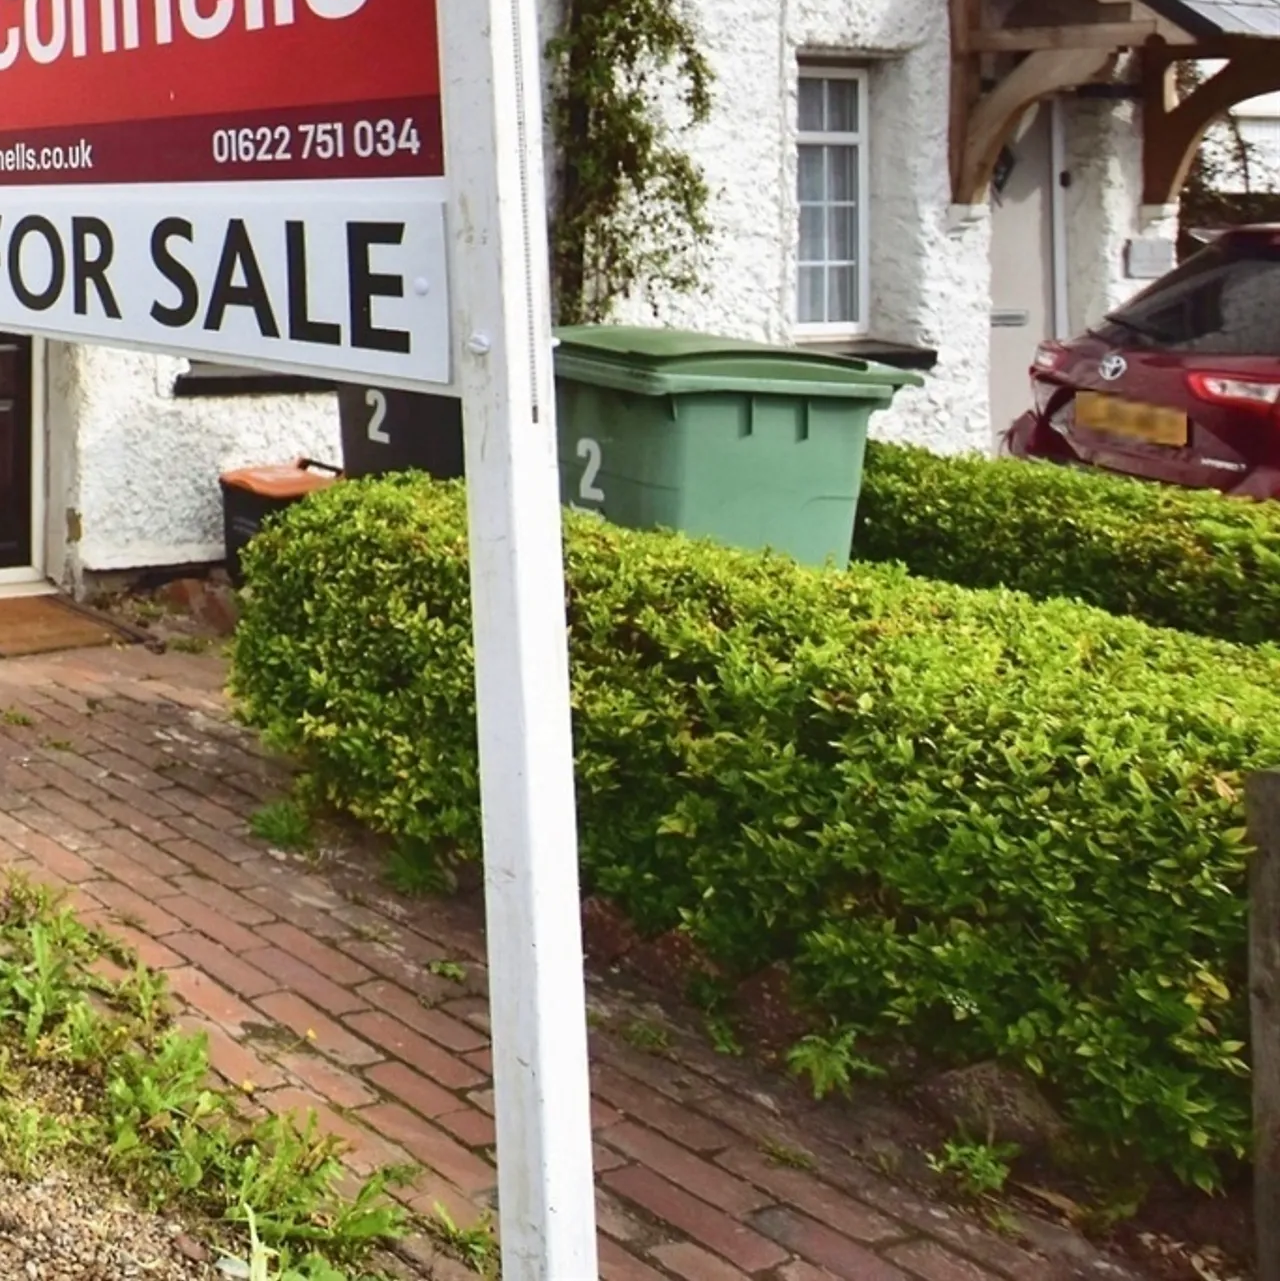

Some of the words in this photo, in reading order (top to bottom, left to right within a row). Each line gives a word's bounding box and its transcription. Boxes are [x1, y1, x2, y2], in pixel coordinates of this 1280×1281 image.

[212, 125, 292, 163] 01622
[297, 122, 344, 160] 751
[353, 117, 421, 158] 034
[150, 217, 411, 354] SALE
[365, 389, 390, 444] 2
[576, 437, 605, 502] 2
